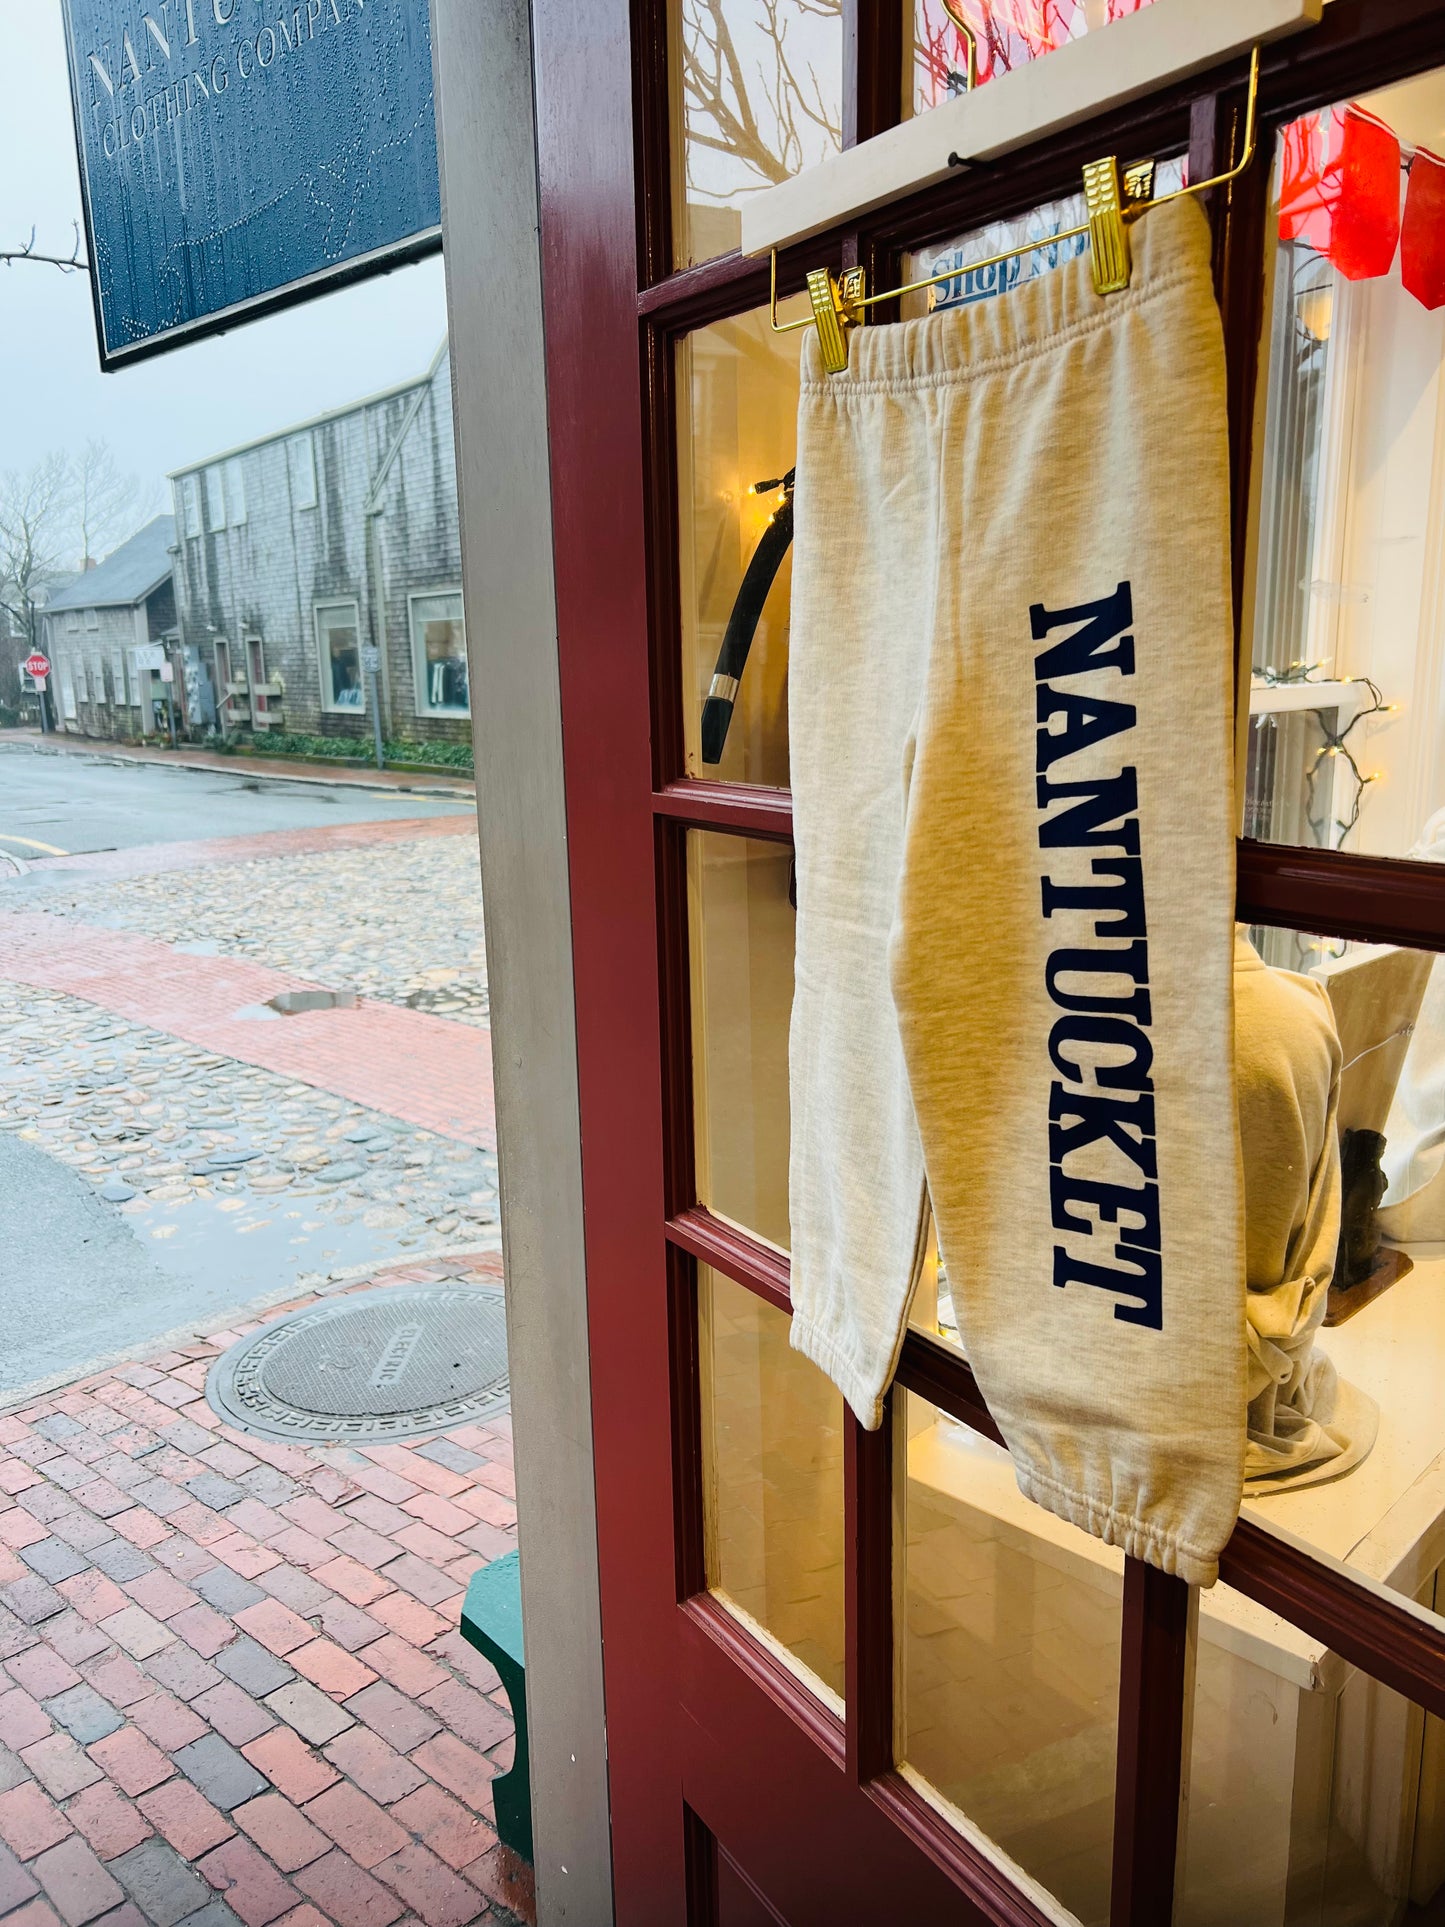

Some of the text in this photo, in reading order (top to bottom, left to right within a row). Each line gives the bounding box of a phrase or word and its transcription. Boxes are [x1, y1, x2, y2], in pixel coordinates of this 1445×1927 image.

[103, 54, 229, 157] CLOTHING
[932, 250, 1019, 303] Shop
[28, 661, 49, 671] STOP
[1029, 581, 1162, 1330] NANTUCKET
